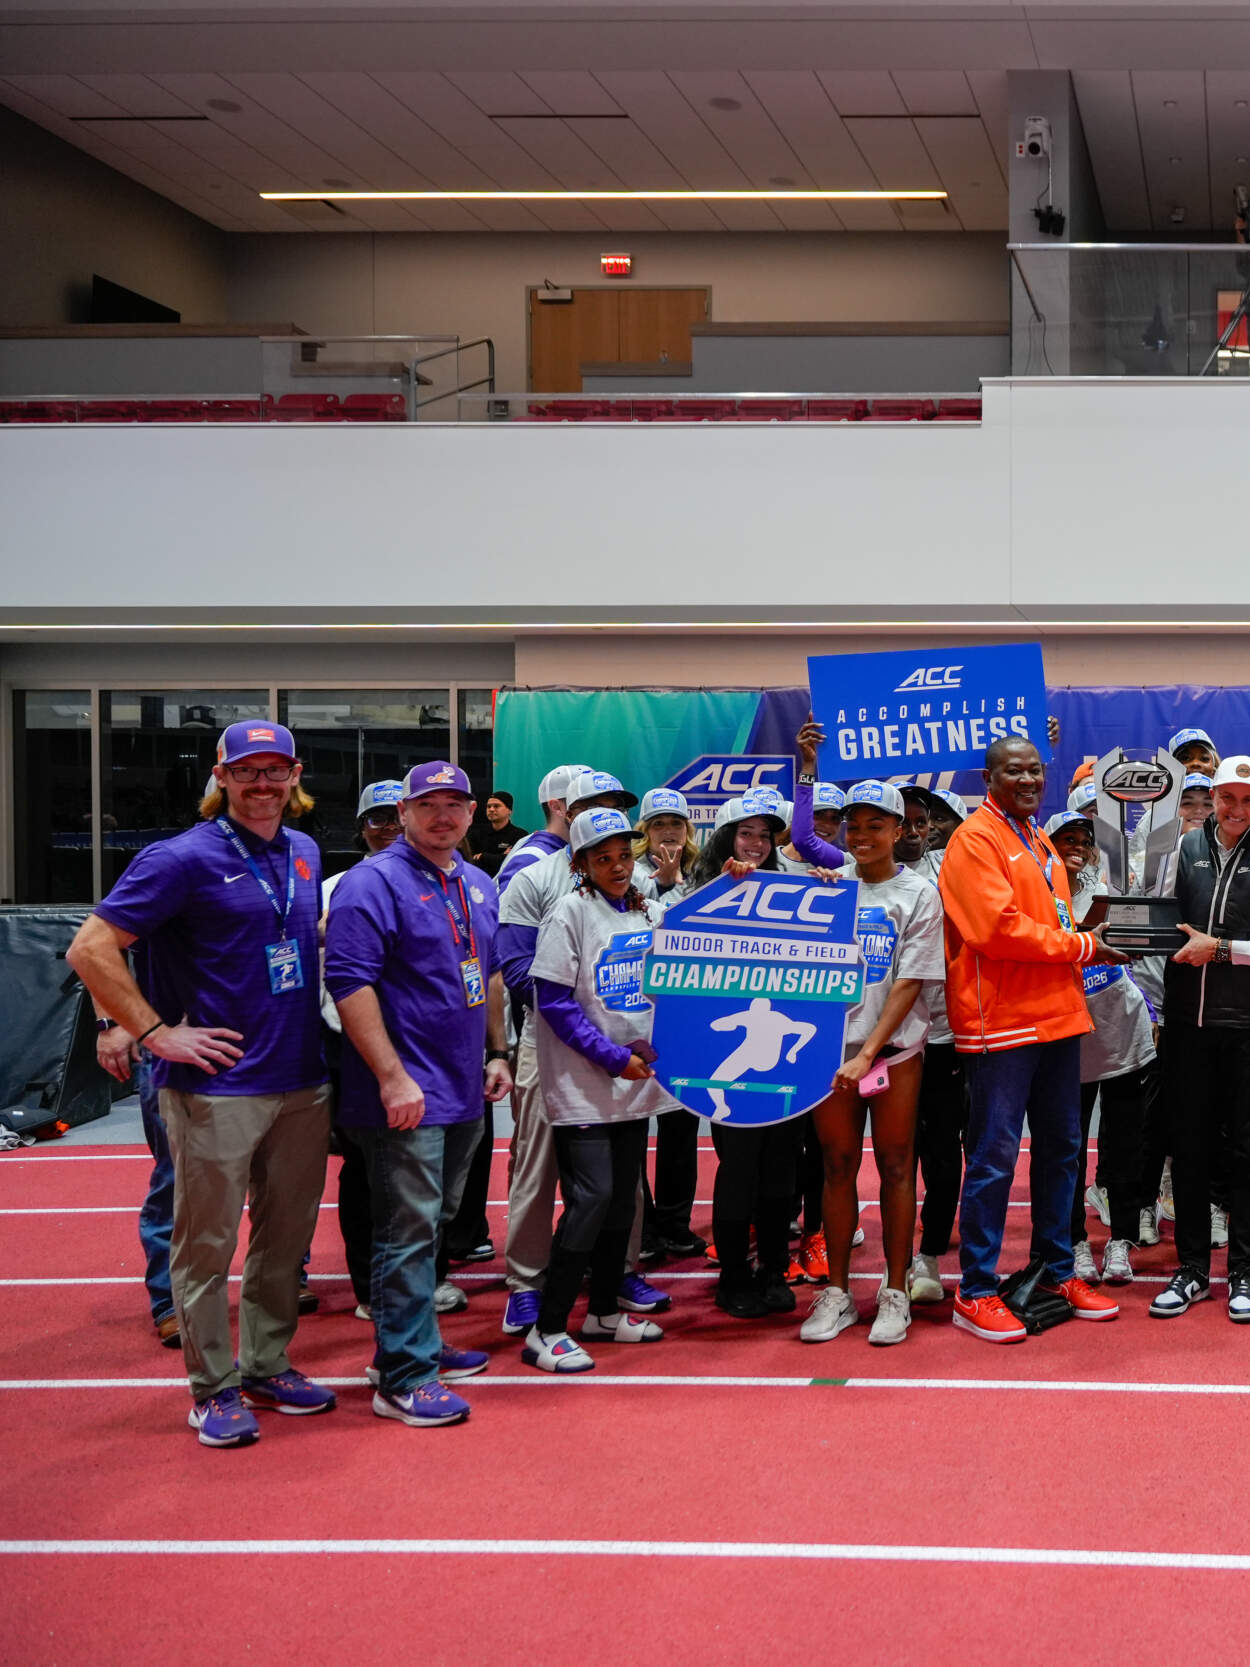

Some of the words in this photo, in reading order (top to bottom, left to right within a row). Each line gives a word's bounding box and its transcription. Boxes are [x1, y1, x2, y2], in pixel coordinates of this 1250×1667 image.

[899, 666, 964, 687] ACC
[837, 696, 1025, 724] ACCOMPLISH
[838, 715, 1029, 761] GREATNESS
[679, 764, 786, 792] ACC
[1103, 771, 1168, 792] ACC
[695, 881, 848, 923] ACC
[625, 934, 649, 947] ACC
[664, 935, 723, 952] INDOOR
[731, 939, 782, 956] TRACK
[789, 944, 799, 956] &
[806, 945, 847, 959] FIELD
[649, 962, 858, 996] CHAMPIONSHIPS
